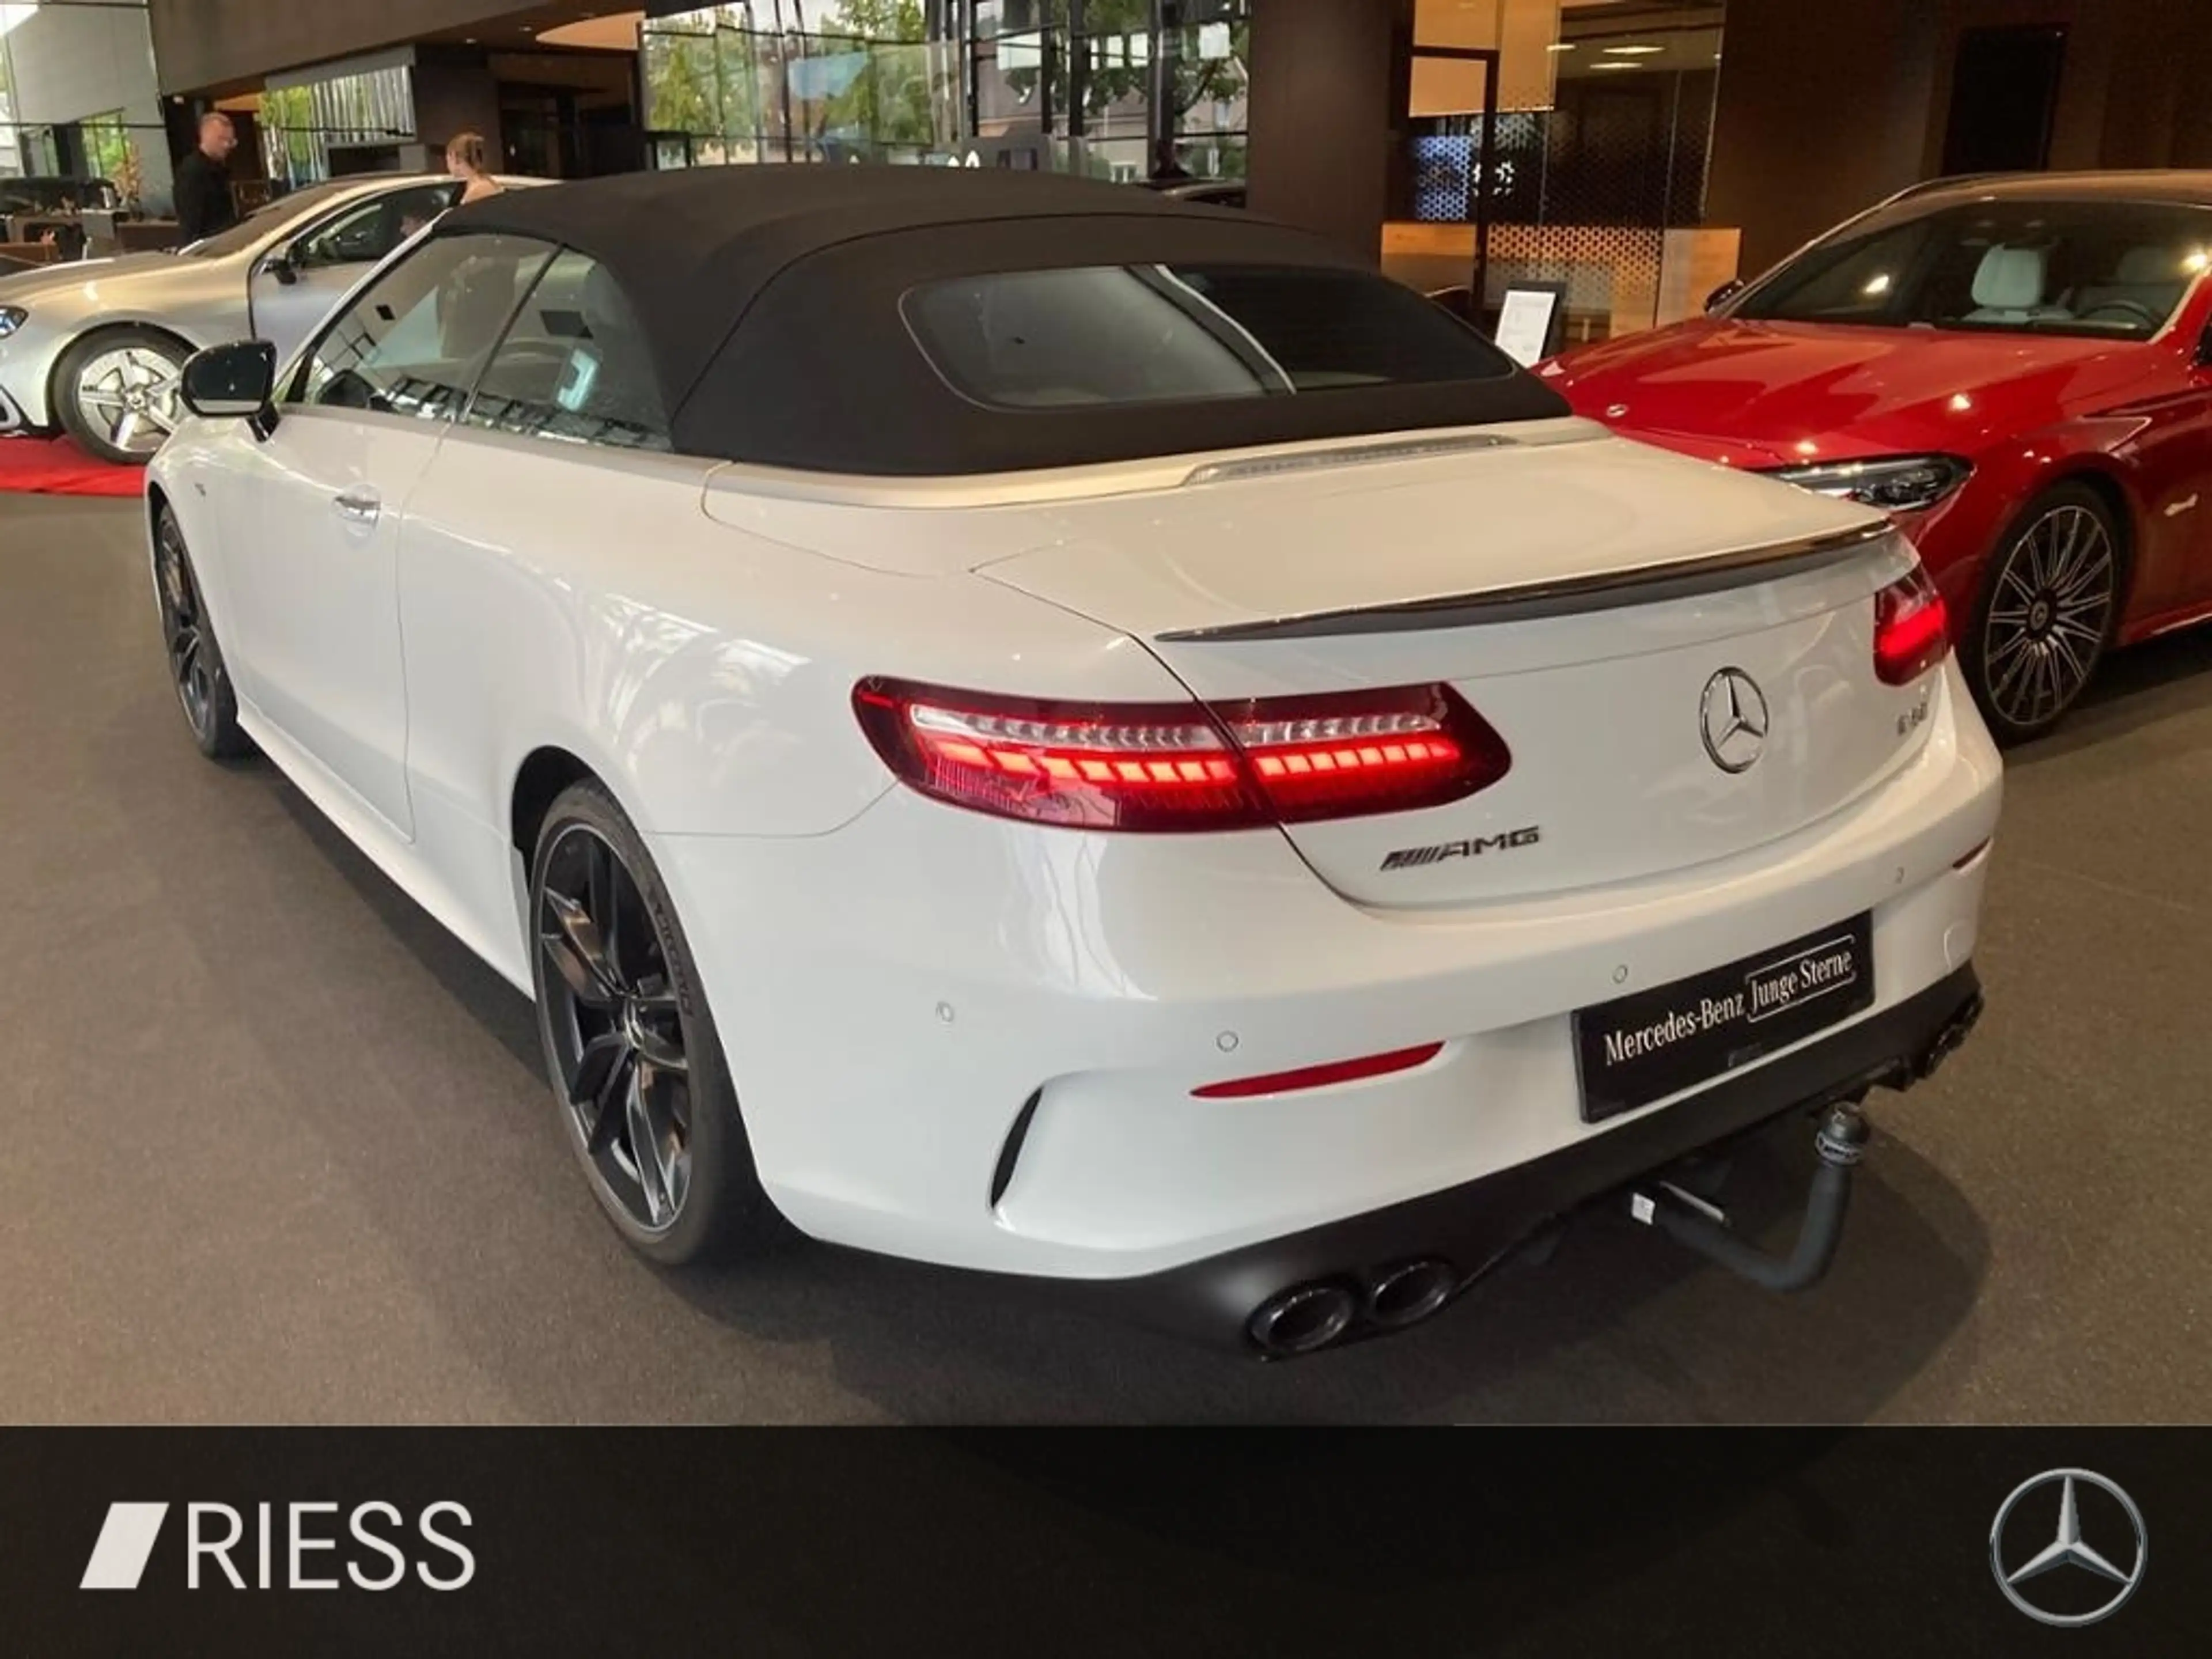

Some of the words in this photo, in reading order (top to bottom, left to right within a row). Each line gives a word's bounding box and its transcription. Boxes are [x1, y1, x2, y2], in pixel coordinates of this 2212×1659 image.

[1438, 824, 1539, 862] AMG
[1605, 991, 1745, 1066] Mercedes-Benz
[1749, 968, 1798, 1012] Junge
[1800, 949, 1854, 989] Sterne
